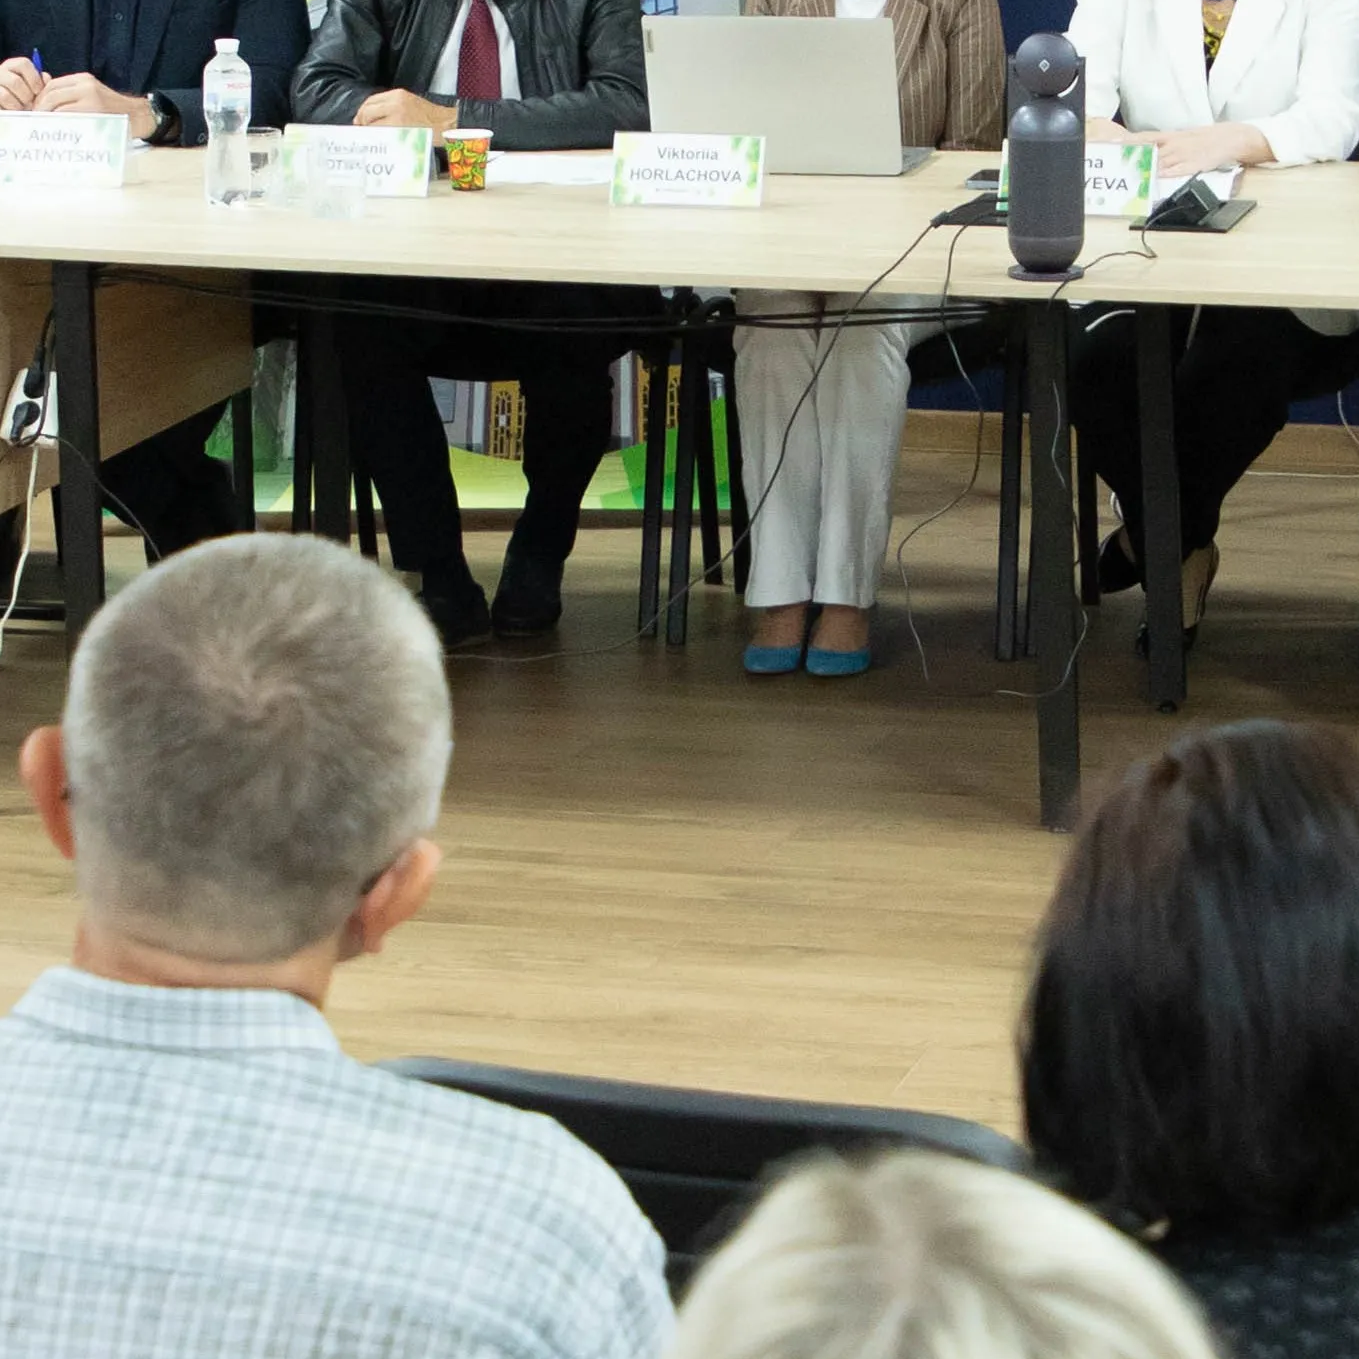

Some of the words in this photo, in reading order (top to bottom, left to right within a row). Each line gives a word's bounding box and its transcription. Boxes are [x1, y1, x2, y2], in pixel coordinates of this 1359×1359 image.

[29, 129, 82, 144] Andriy
[657, 146, 719, 160] Viktoriia
[630, 168, 742, 182] HORLACHOVA
